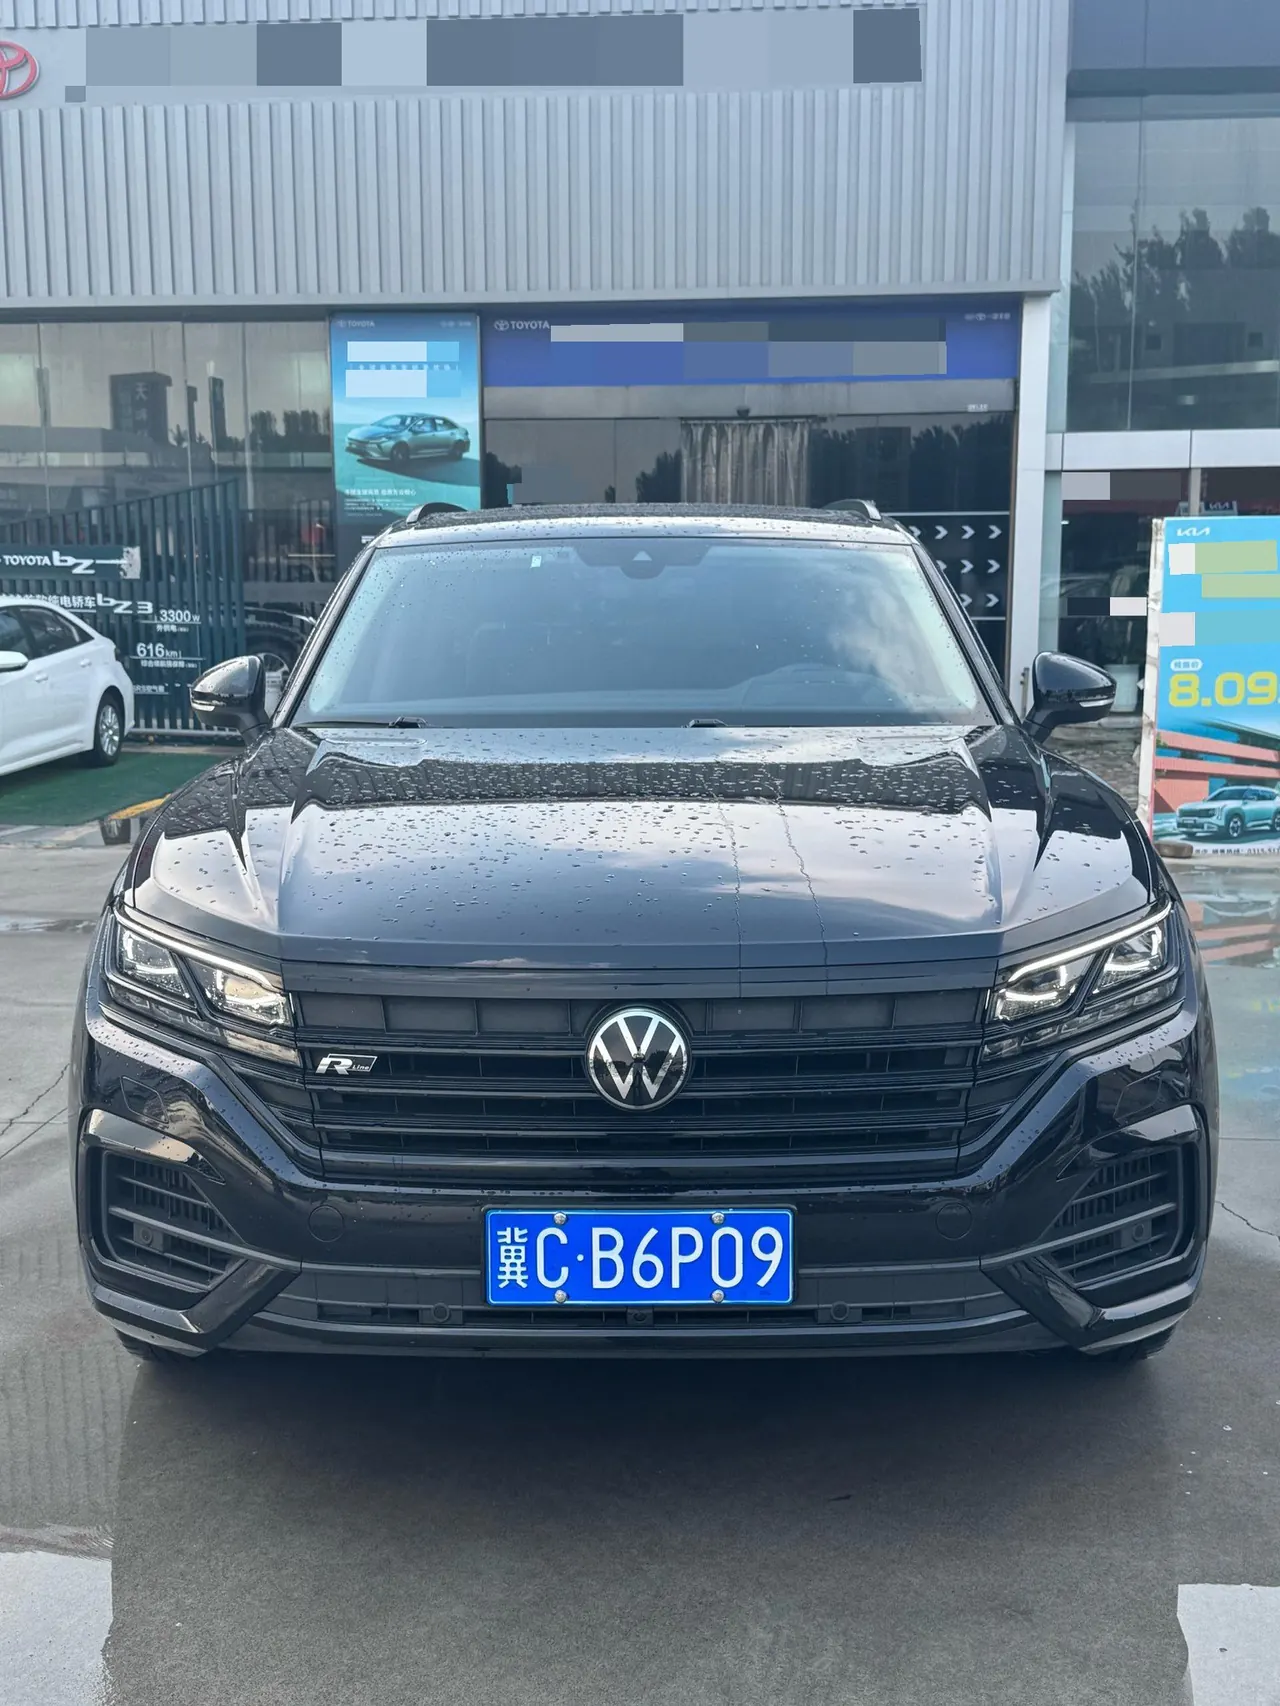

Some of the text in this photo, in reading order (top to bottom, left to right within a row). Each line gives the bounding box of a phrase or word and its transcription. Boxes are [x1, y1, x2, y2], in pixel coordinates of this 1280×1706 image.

[347, 320, 375, 328] TOYOTA
[511, 320, 550, 329] TOYOTA
[3, 555, 51, 566] TOYOTA
[1168, 671, 1278, 707] 8.09
